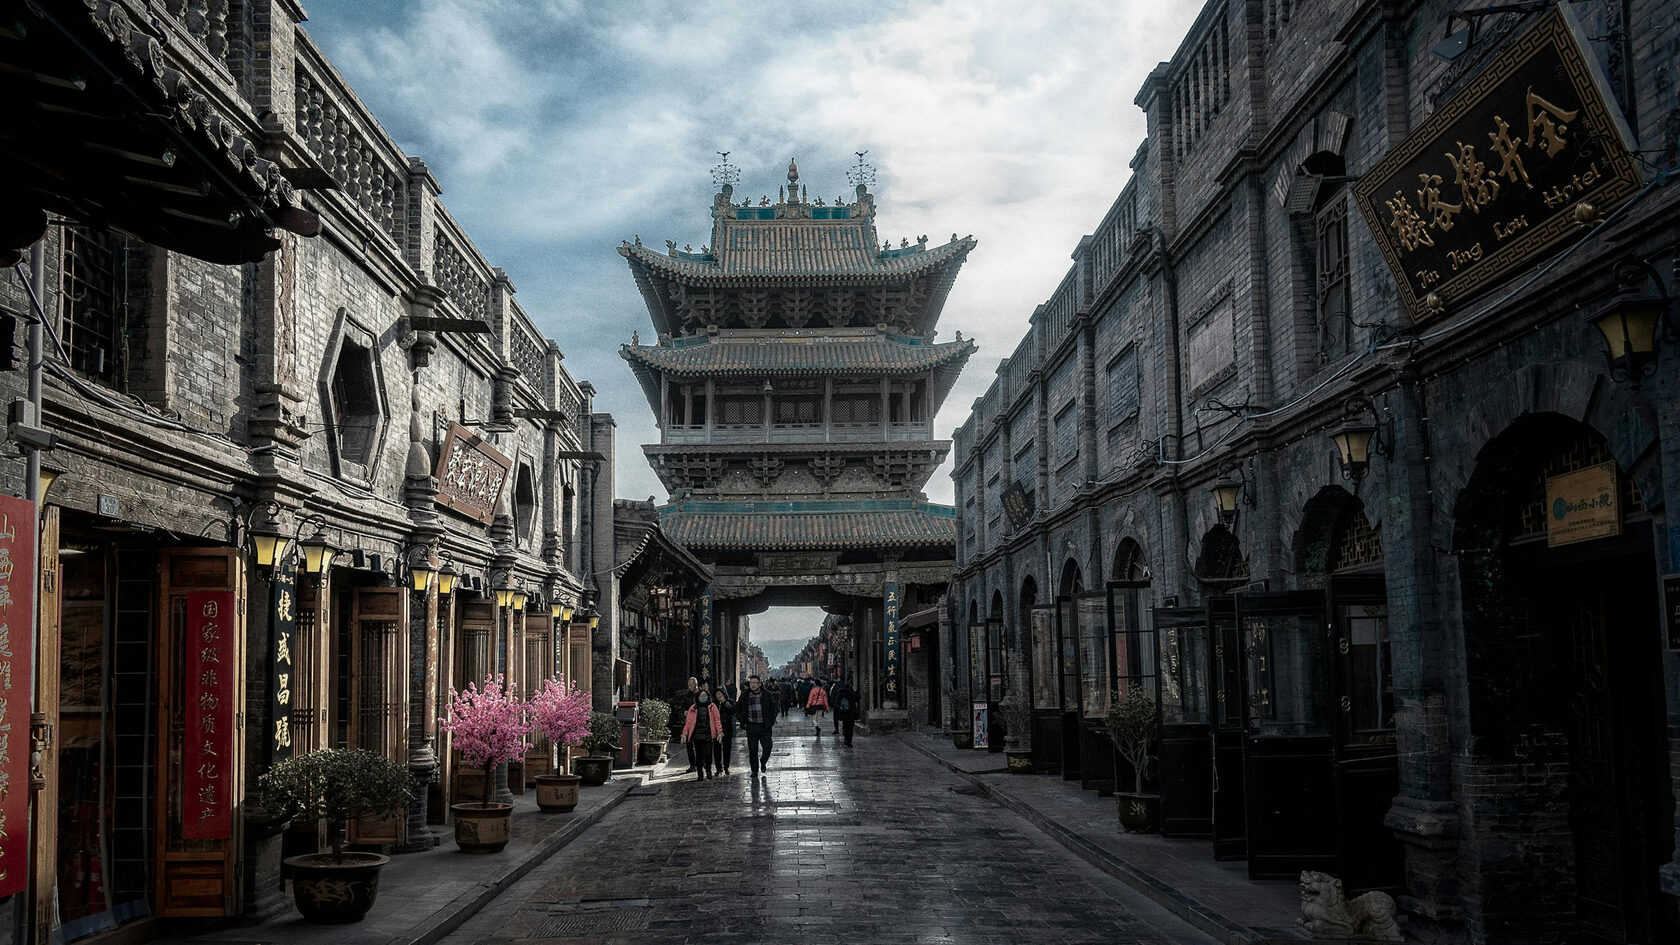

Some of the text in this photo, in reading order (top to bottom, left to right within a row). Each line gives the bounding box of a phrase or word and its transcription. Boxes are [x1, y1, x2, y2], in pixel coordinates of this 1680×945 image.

[1416, 162, 1602, 289] Jin Jing Lou Hotel
[198, 600, 220, 825] 国家级非物质文化遗产
